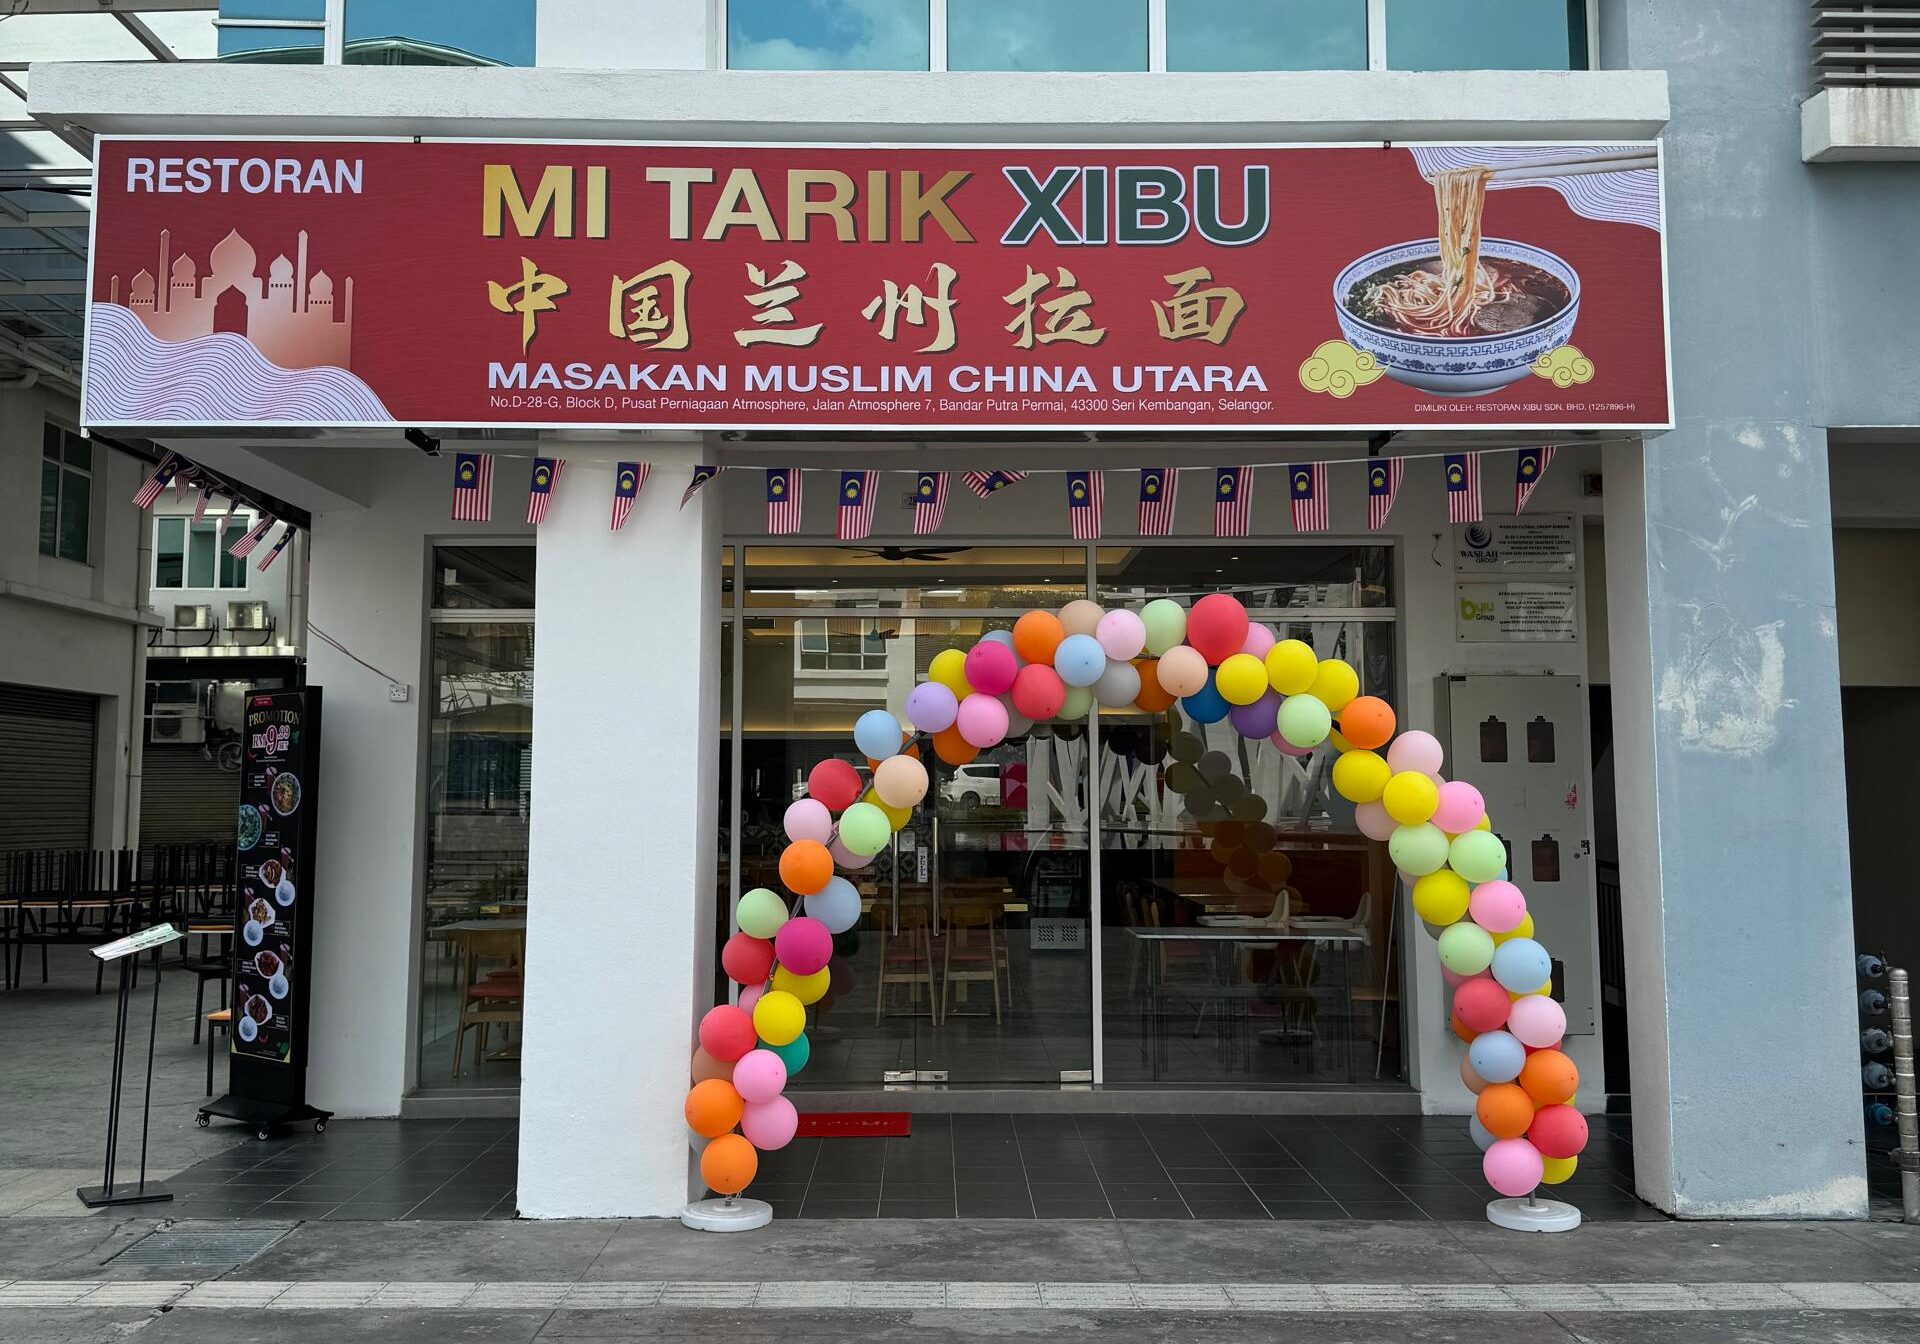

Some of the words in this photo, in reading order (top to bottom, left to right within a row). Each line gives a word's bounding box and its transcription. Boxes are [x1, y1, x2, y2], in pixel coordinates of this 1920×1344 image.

[126, 157, 364, 195] RESTORAN
[482, 164, 609, 239] MI
[645, 166, 977, 244] TARIK
[1000, 163, 1272, 249] XIBU
[485, 256, 1247, 356] 中国兰州拉面
[488, 362, 727, 391] MASAKAN
[744, 365, 932, 393] MUSLIM
[948, 365, 1098, 393] CHINA
[1112, 365, 1269, 393] UTARA
[490, 396, 562, 410] No.D-28-G,
[566, 396, 601, 409] Block
[604, 396, 618, 411] D,
[622, 397, 657, 410] Pusat
[660, 397, 729, 413] Perniagaan
[732, 398, 809, 414] Atmosphere,
[813, 398, 845, 411] Jalan
[848, 398, 921, 414] Atmosphere
[924, 399, 936, 413] 7,
[939, 399, 983, 412] Bandar
[986, 399, 1018, 412] Putra
[1021, 399, 1067, 413] Permai,
[1070, 399, 1108, 412] 43300
[1112, 399, 1135, 412] Seri
[1139, 399, 1215, 415] Kembangan,
[1218, 399, 1275, 415] Selangor.
[1414, 403, 1448, 412] DIMILIKI
[1449, 403, 1474, 412] OLEH:
[1475, 403, 1521, 412] RESTORAN
[1522, 403, 1542, 411] XIBU
[1544, 403, 1564, 411] SDN.
[1566, 403, 1587, 411] BHD.
[1588, 402, 1636, 412] (1257896-H)
[1460, 550, 1498, 559] WASILAH
[1476, 614, 1495, 622] Group
[248, 709, 301, 727] PROMOTION
